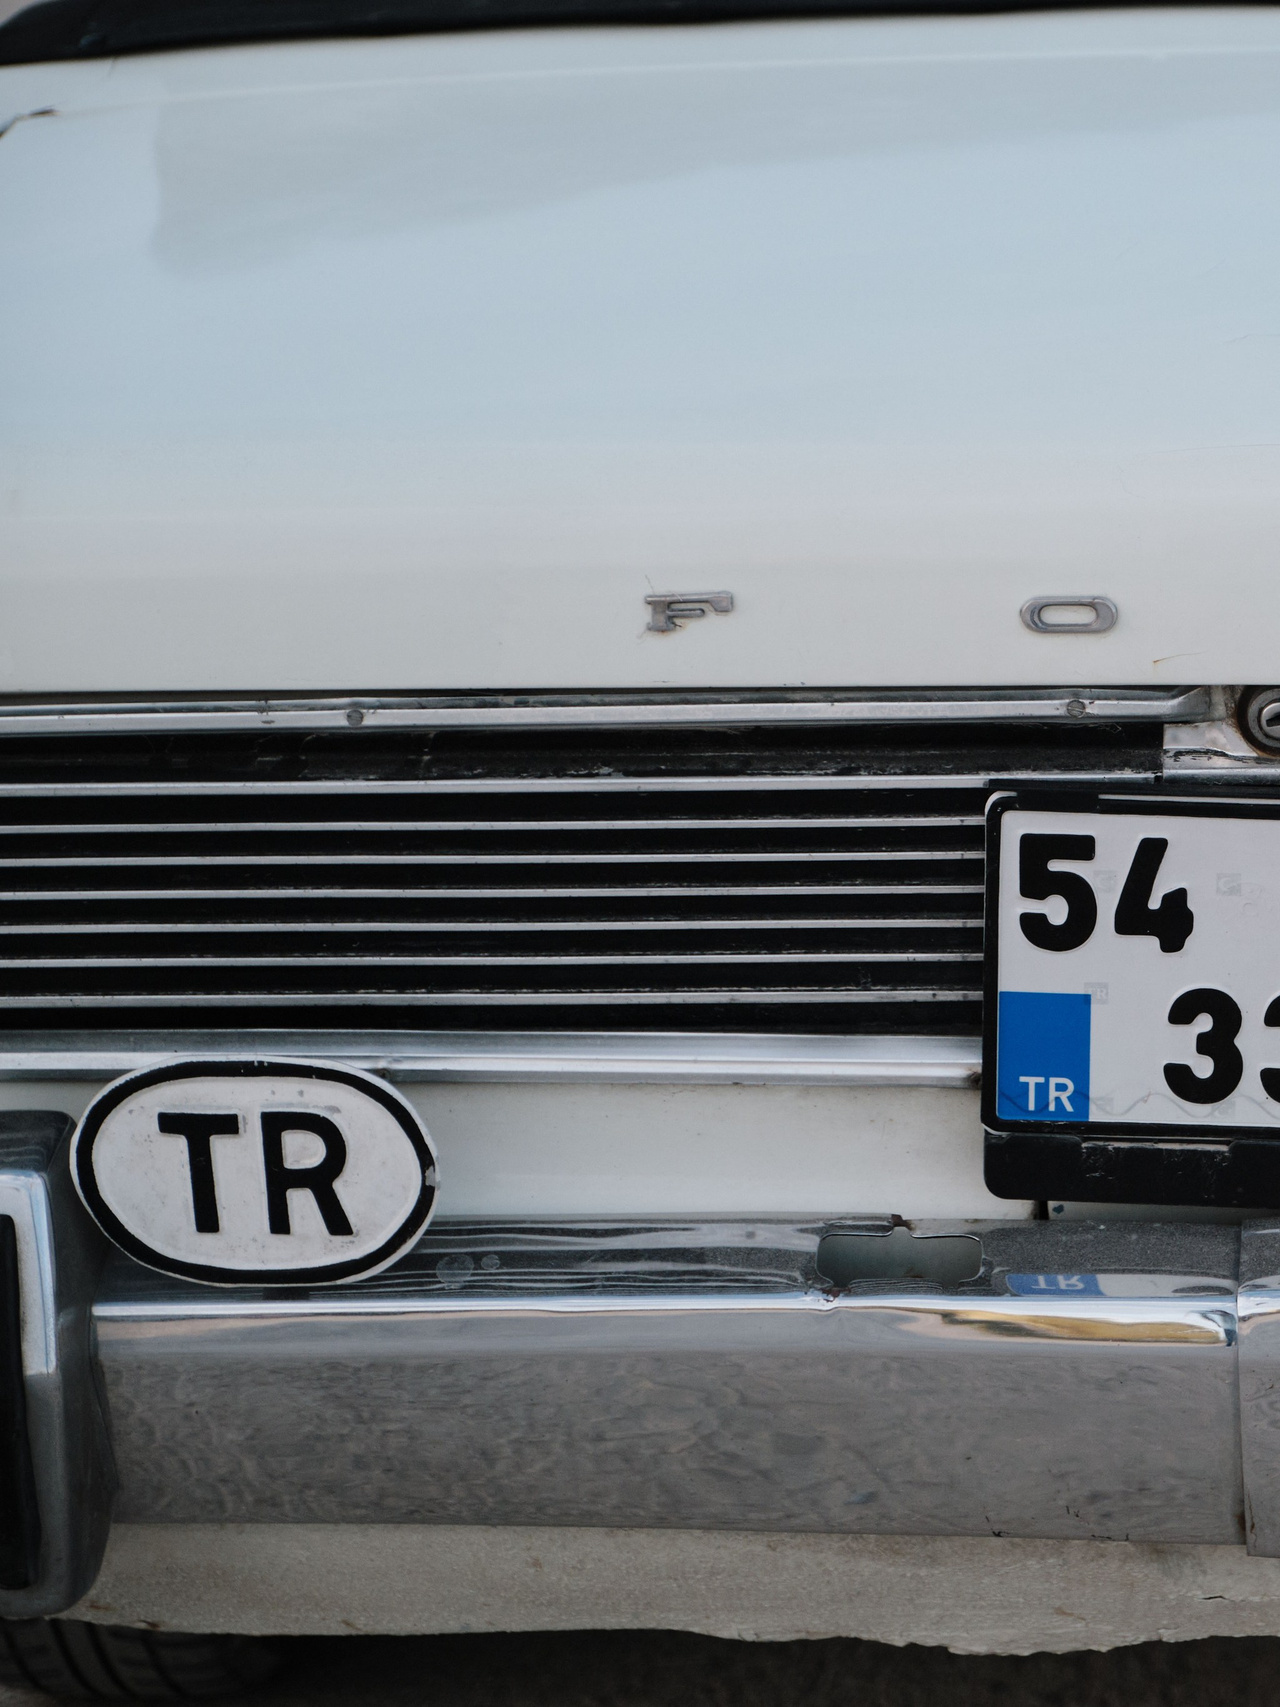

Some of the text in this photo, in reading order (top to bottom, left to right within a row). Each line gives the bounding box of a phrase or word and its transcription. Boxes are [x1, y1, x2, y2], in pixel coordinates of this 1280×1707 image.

[1019, 833, 1194, 953] 54
[1019, 1076, 1074, 1112] TR
[157, 1111, 354, 1236] TR
